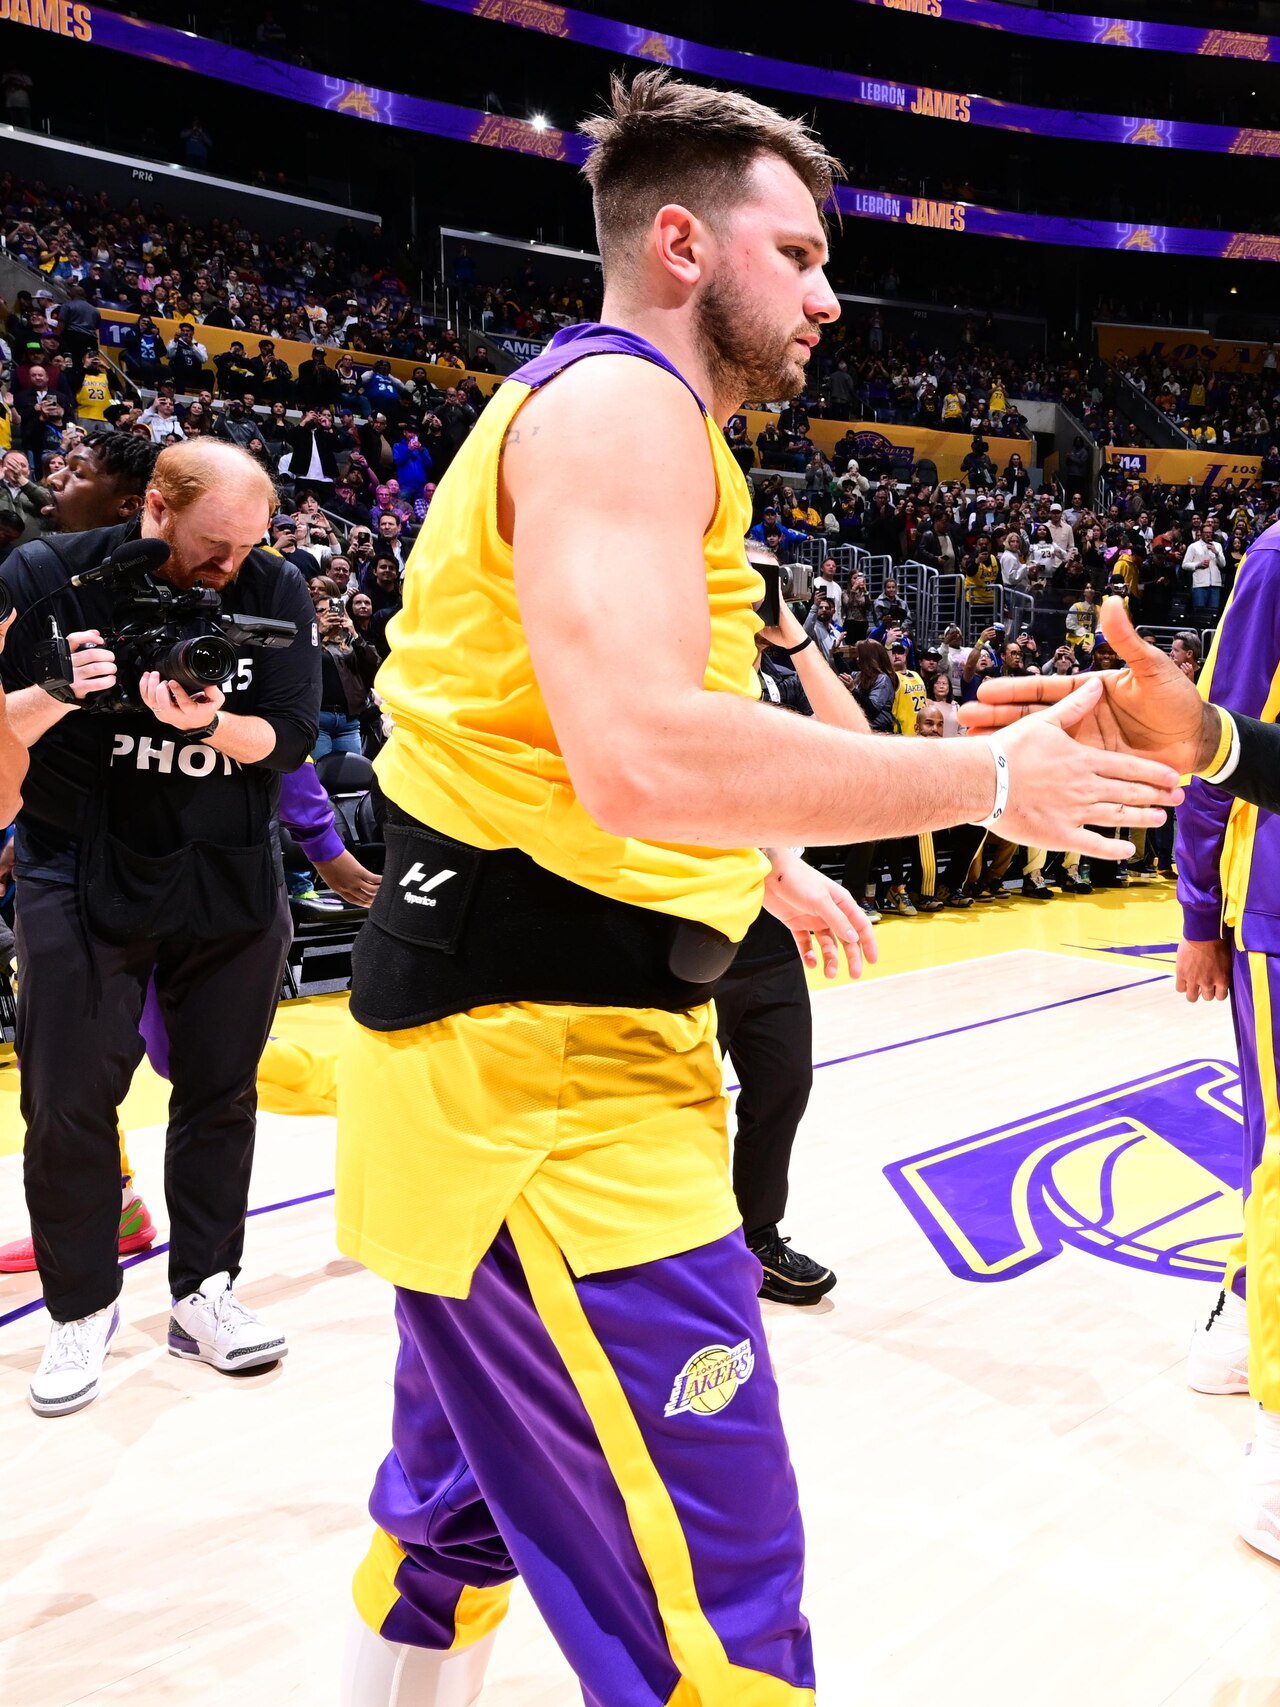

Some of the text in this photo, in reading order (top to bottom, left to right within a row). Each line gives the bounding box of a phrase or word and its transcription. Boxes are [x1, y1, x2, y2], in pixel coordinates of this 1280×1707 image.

[861, 81, 971, 123] LEBRON JAMES
[132, 169, 154, 182] PR16
[856, 193, 966, 232] LEBRON JAMES
[502, 339, 547, 356] AME
[88, 388, 105, 400] 23
[1231, 465, 1258, 475] LOS
[110, 733, 244, 778] PHO
[695, 1343, 749, 1377] LOS ANGELES
[668, 1352, 753, 1410] LAKERS
